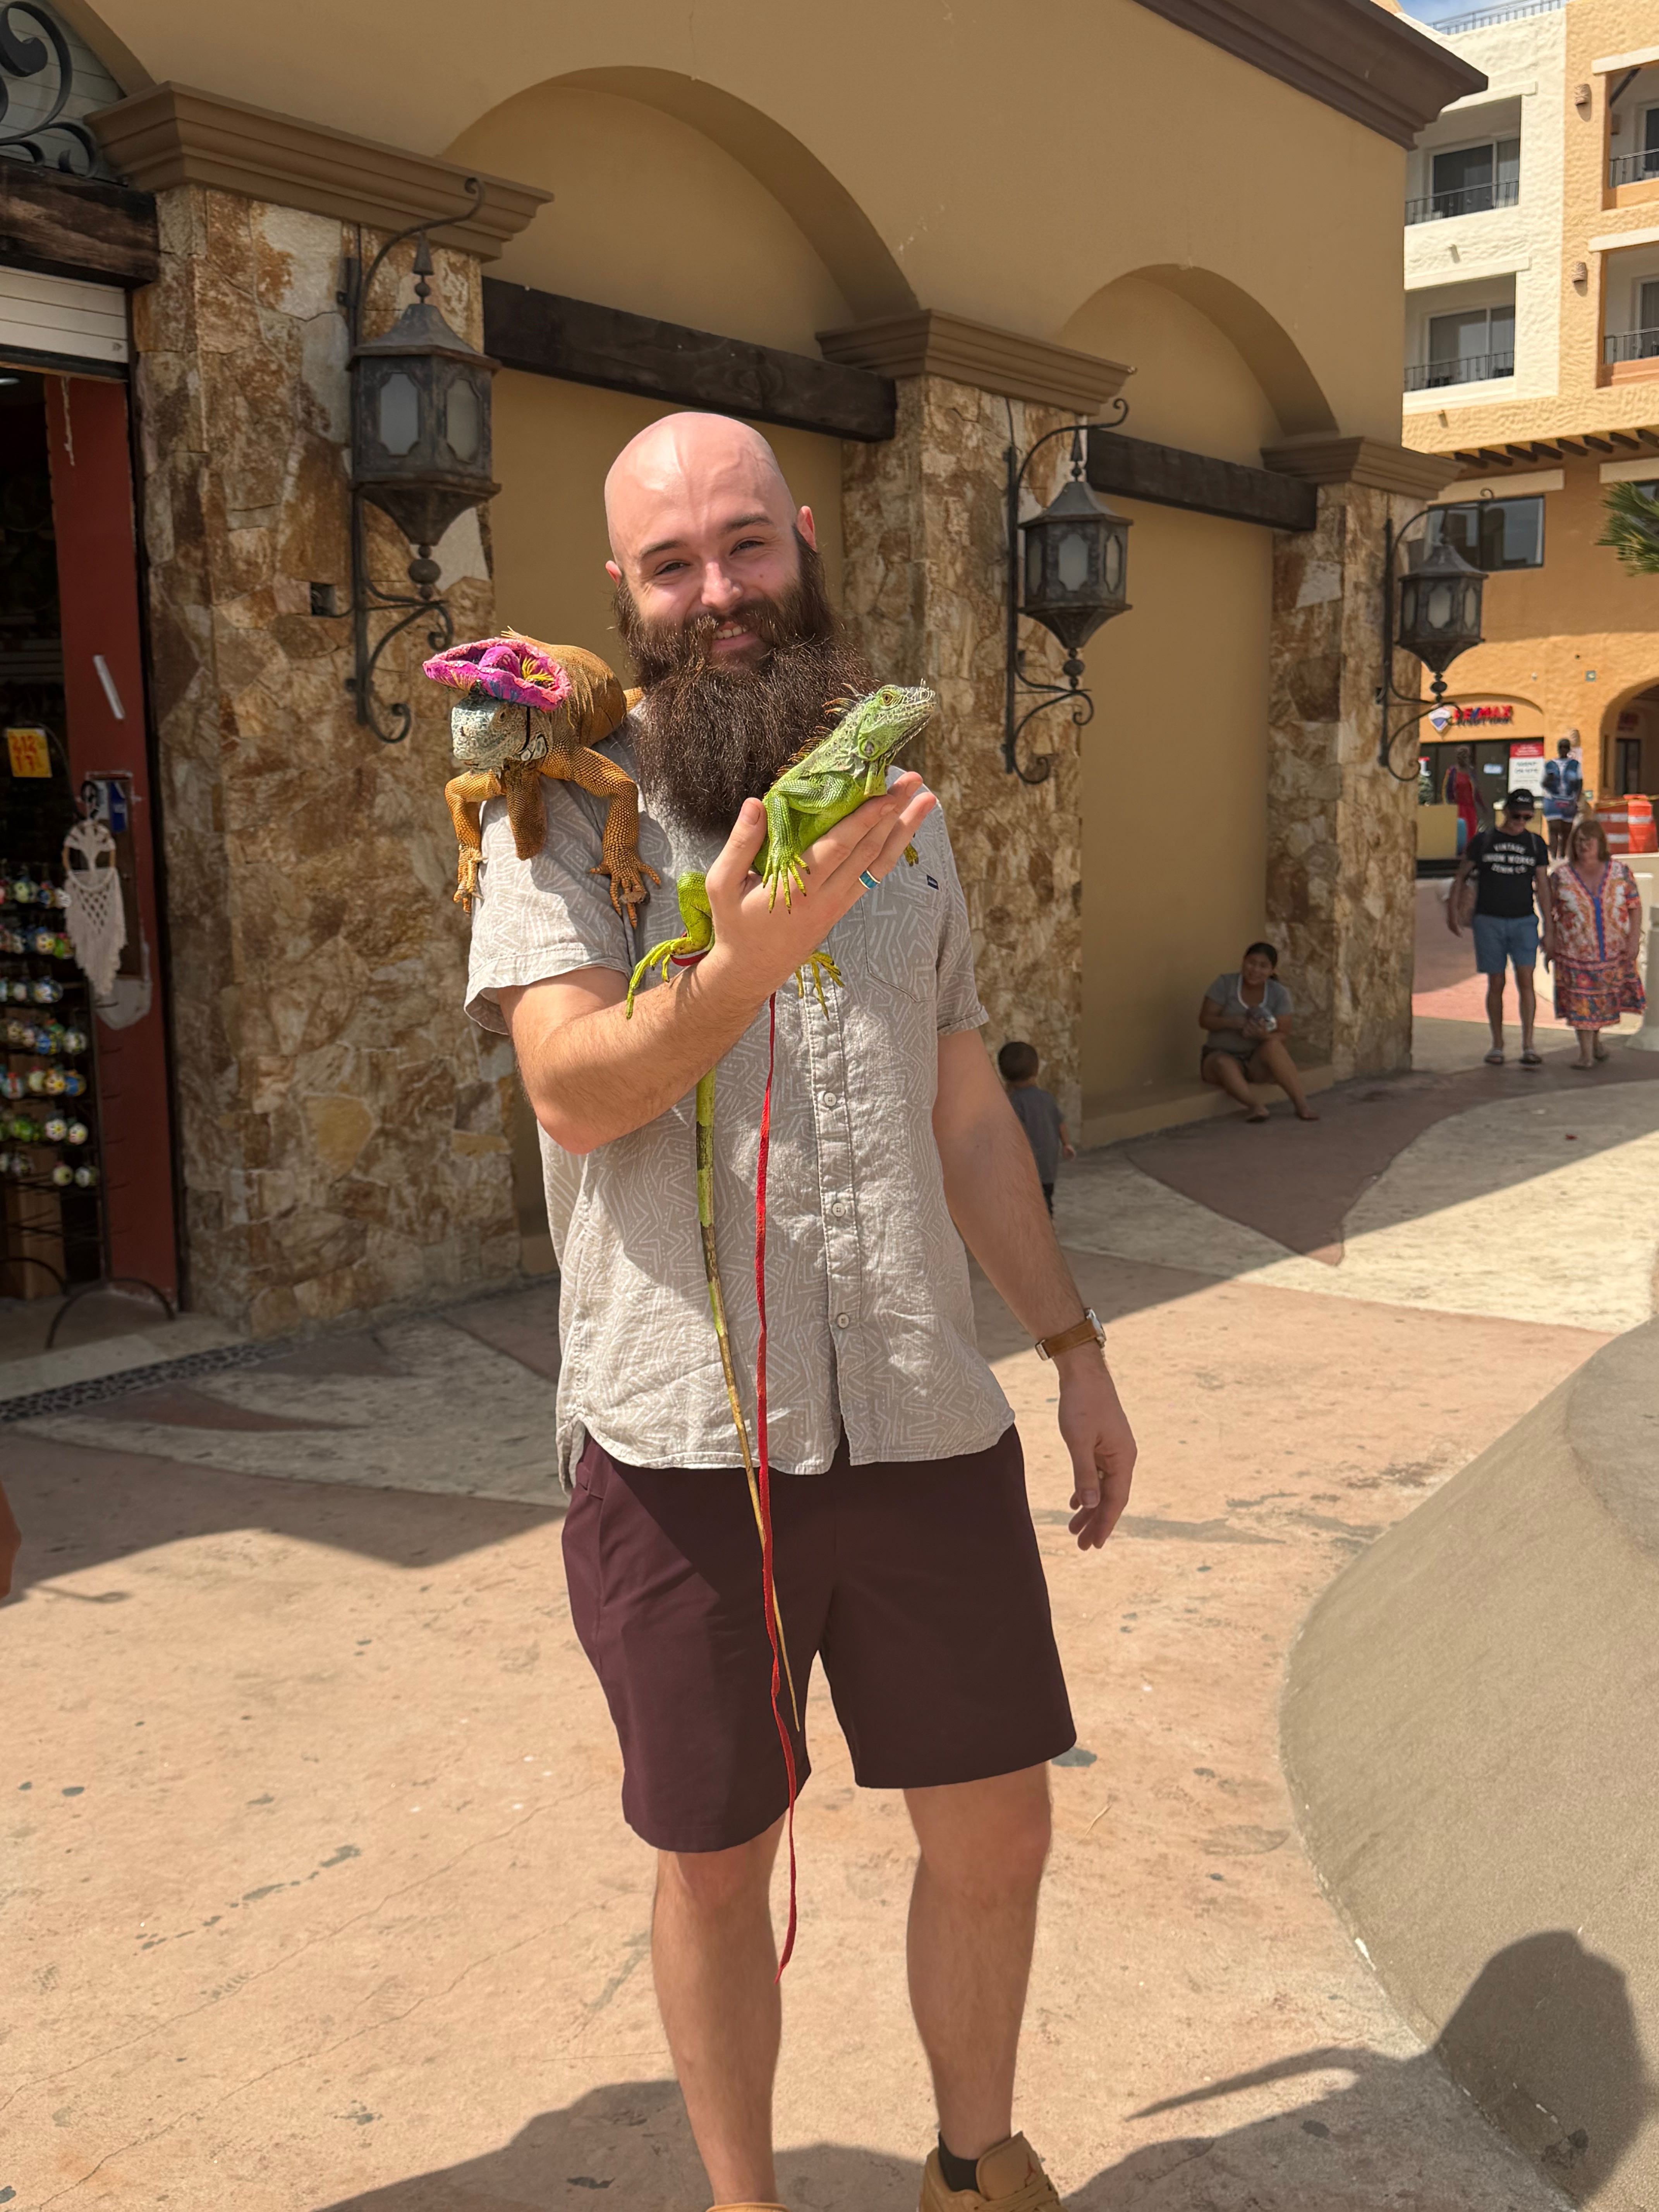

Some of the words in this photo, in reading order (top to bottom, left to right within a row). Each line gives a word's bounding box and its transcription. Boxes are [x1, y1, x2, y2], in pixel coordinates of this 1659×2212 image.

[1493, 842, 1526, 854] VINTAGE
[1482, 853, 1506, 863] UNION
[1508, 854, 1536, 867] WORKS
